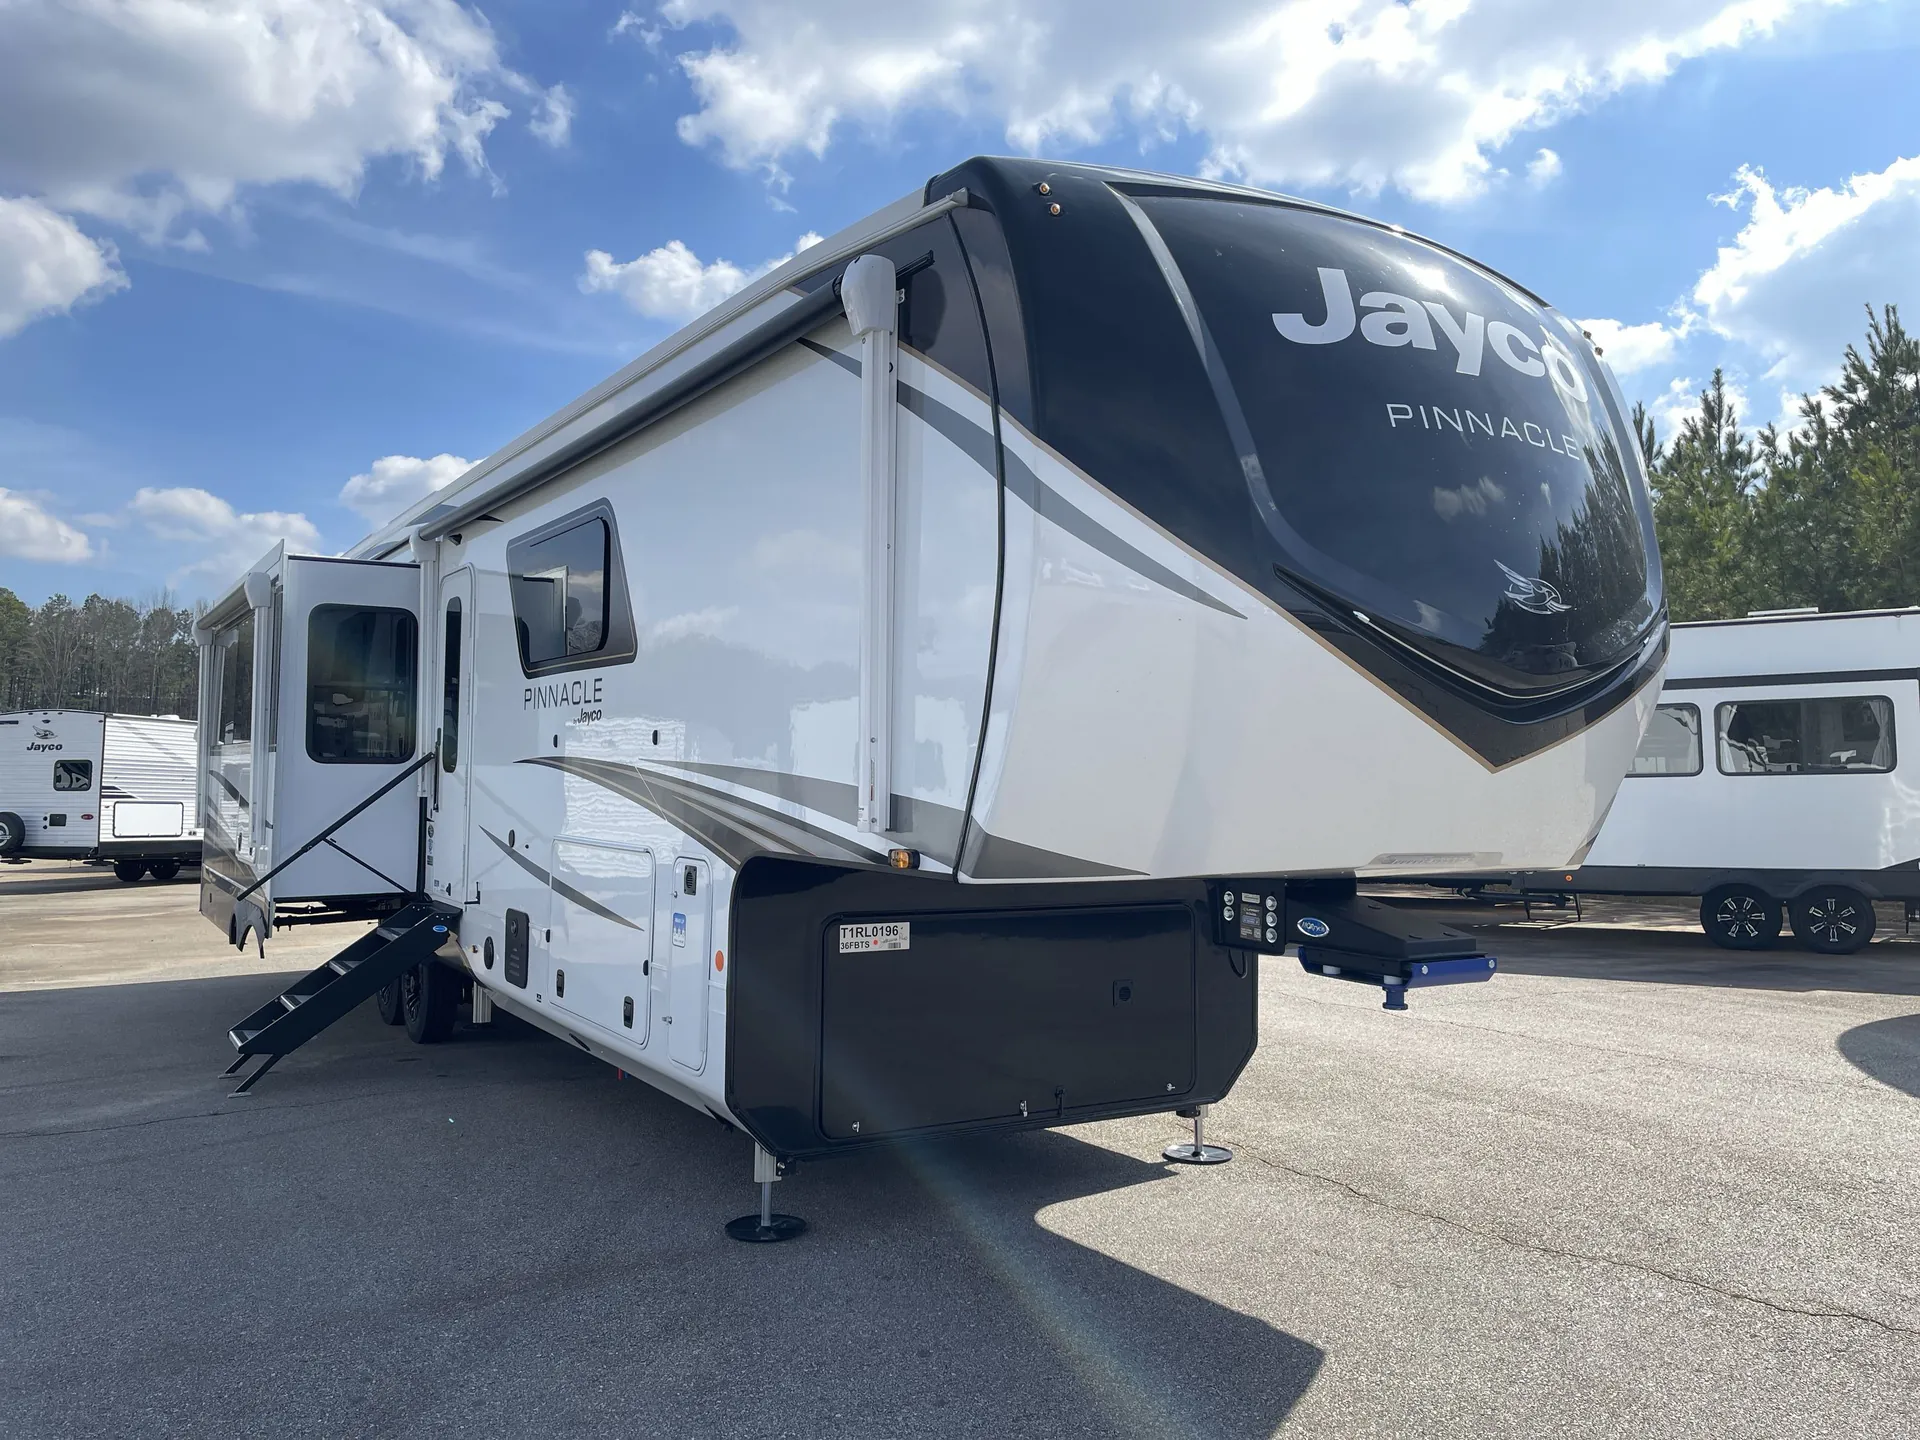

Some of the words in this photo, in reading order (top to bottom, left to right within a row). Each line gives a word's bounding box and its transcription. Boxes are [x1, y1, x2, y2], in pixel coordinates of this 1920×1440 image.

[1271, 266, 1589, 403] Jayco
[1386, 402, 1581, 461] PINNACLE
[523, 677, 603, 711] PINNACLE
[578, 707, 602, 726] Jayco
[26, 742, 63, 752] Jayco
[840, 925, 899, 939] T1RL0196
[840, 941, 870, 950] 36FBTS
